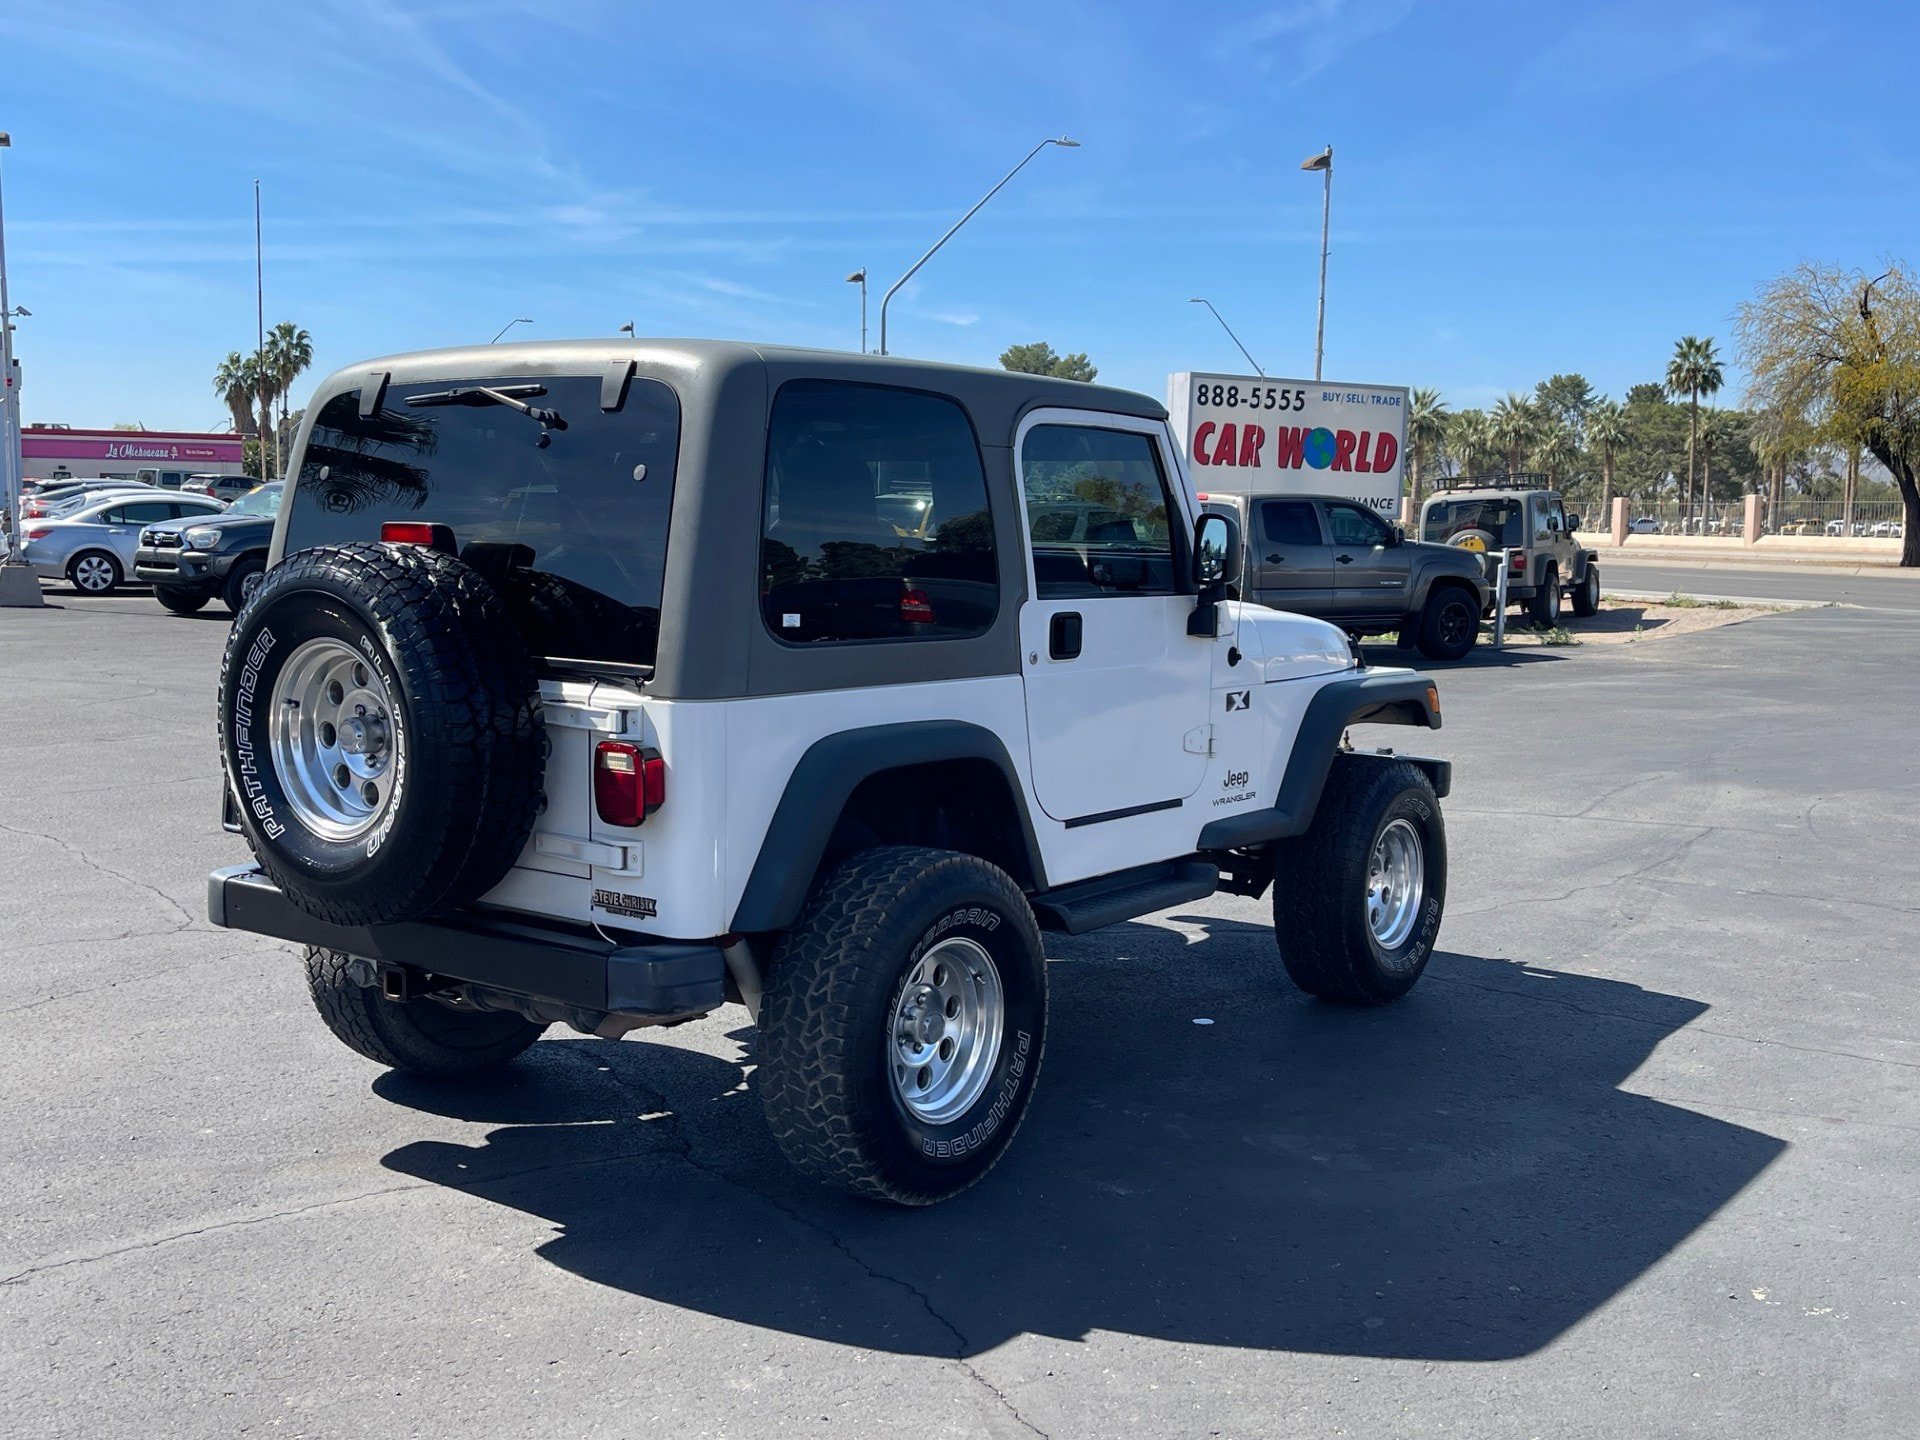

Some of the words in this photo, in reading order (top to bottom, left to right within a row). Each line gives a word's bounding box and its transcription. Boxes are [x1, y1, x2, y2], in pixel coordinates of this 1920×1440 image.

[1197, 384, 1306, 412] 888-5555
[105, 443, 118, 458] La
[1193, 421, 1266, 468] CAR
[1347, 496, 1394, 510] ANCE
[235, 627, 286, 842] PATHFINDER
[1223, 769, 1249, 788] Jeep
[1212, 791, 1257, 807] WRANGLER
[593, 889, 620, 906] STEVE
[922, 1030, 1031, 1158] PATHFINDER
